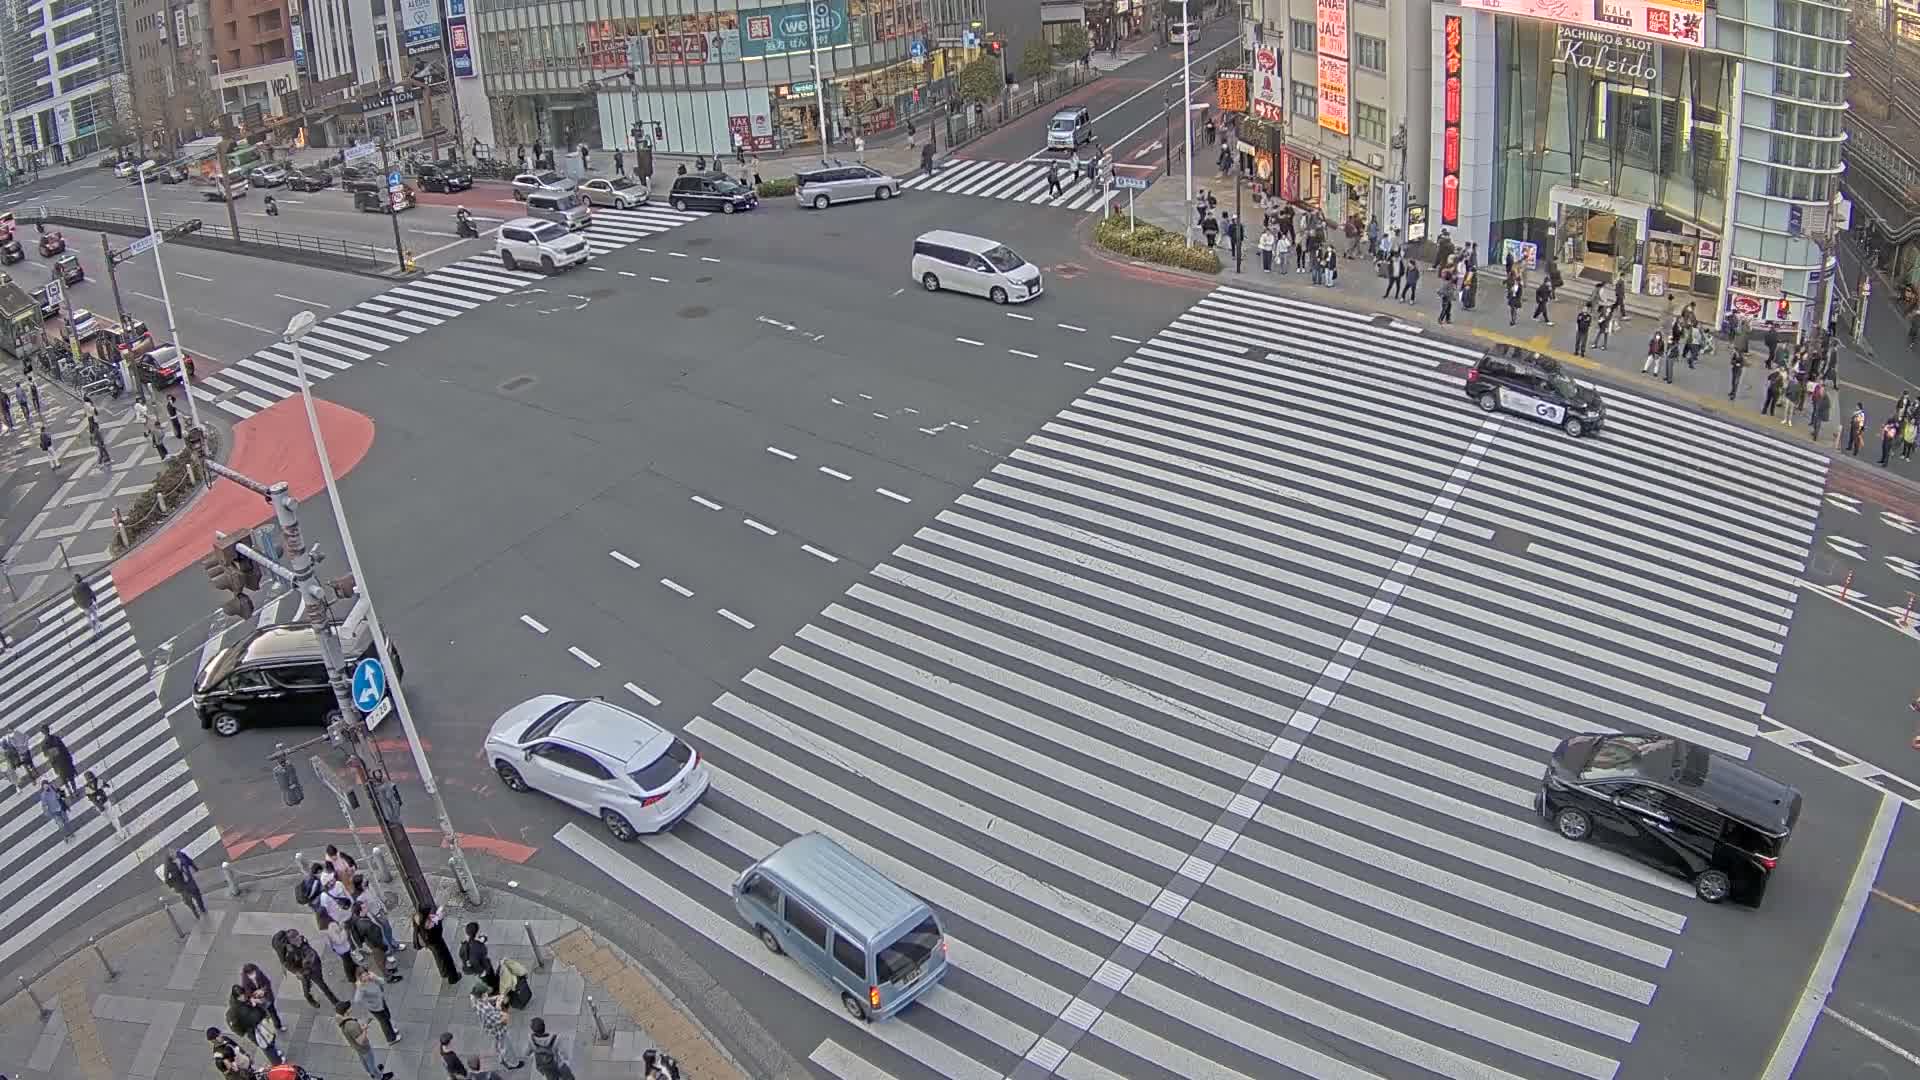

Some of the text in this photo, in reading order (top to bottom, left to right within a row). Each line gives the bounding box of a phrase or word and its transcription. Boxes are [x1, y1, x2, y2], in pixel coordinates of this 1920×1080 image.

[1319, 22, 1339, 38] JAL
[1558, 26, 1653, 51] PACHINKO & SLOT
[1552, 39, 1657, 80] Kaleido
